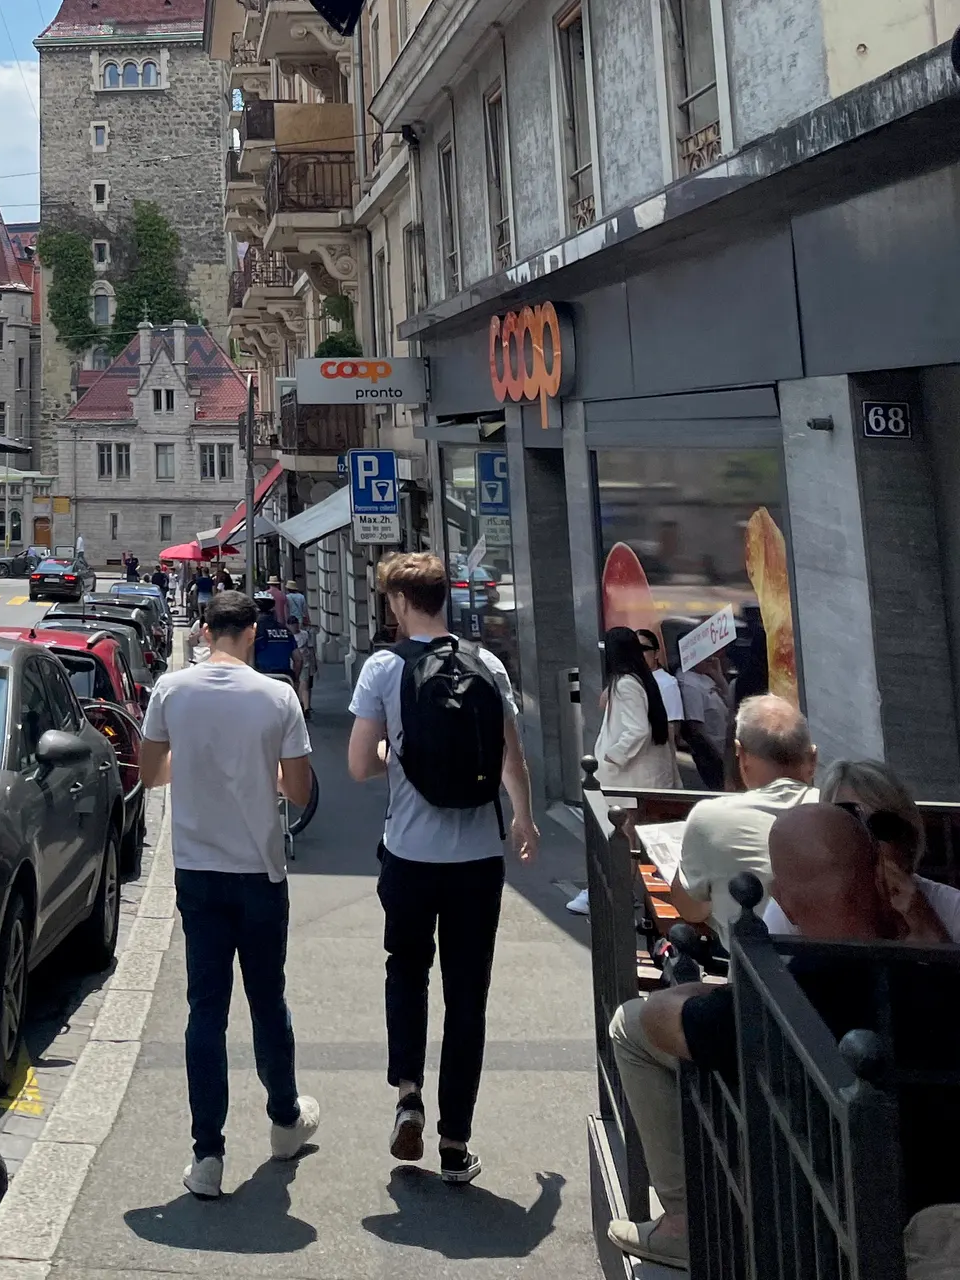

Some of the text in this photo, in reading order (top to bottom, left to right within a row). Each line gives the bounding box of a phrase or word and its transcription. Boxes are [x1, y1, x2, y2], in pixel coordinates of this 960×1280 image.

[320, 361, 392, 384] coop
[489, 300, 561, 429] coop
[355, 387, 403, 400] pronto
[868, 406, 905, 433] 68
[357, 455, 379, 490] P
[267, 629, 289, 638] POLICE
